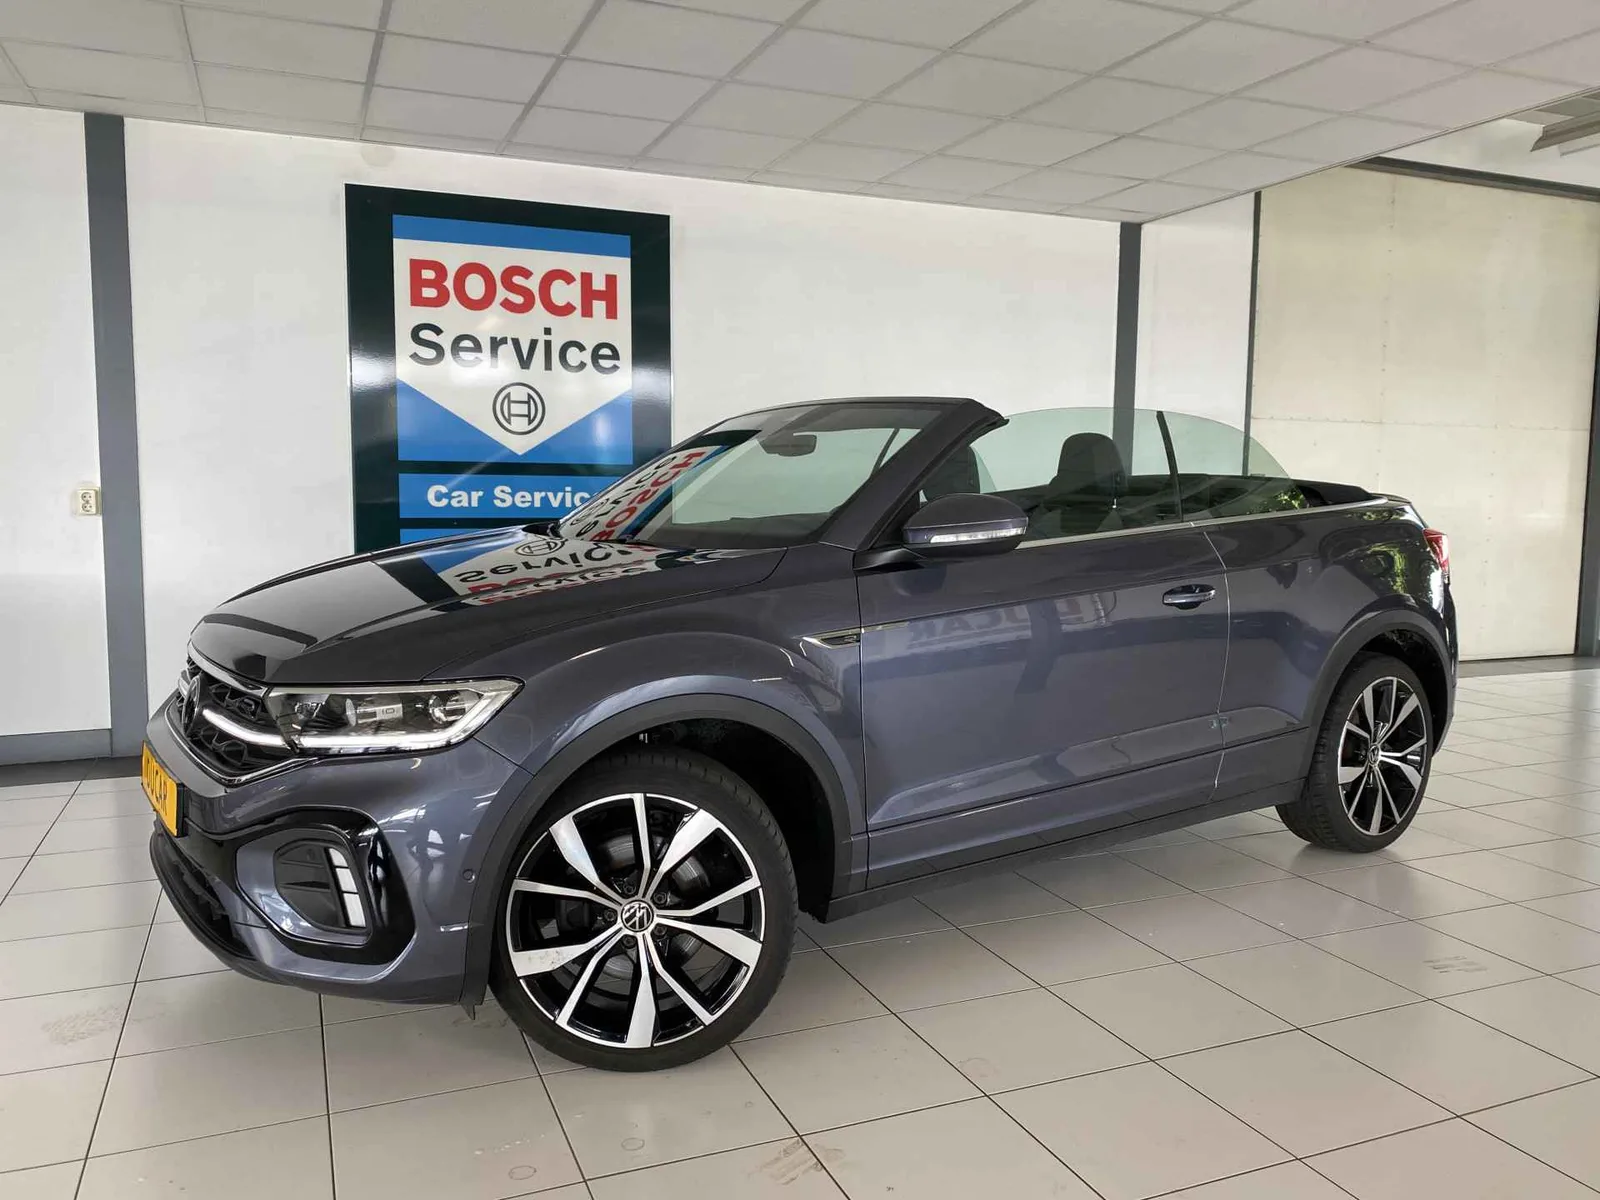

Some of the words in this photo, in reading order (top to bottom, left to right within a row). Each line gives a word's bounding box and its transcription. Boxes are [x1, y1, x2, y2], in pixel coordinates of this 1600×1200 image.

[408, 258, 618, 320] BOSCH
[408, 322, 621, 375] Service
[426, 484, 484, 508] Car
[492, 485, 598, 509] Servic
